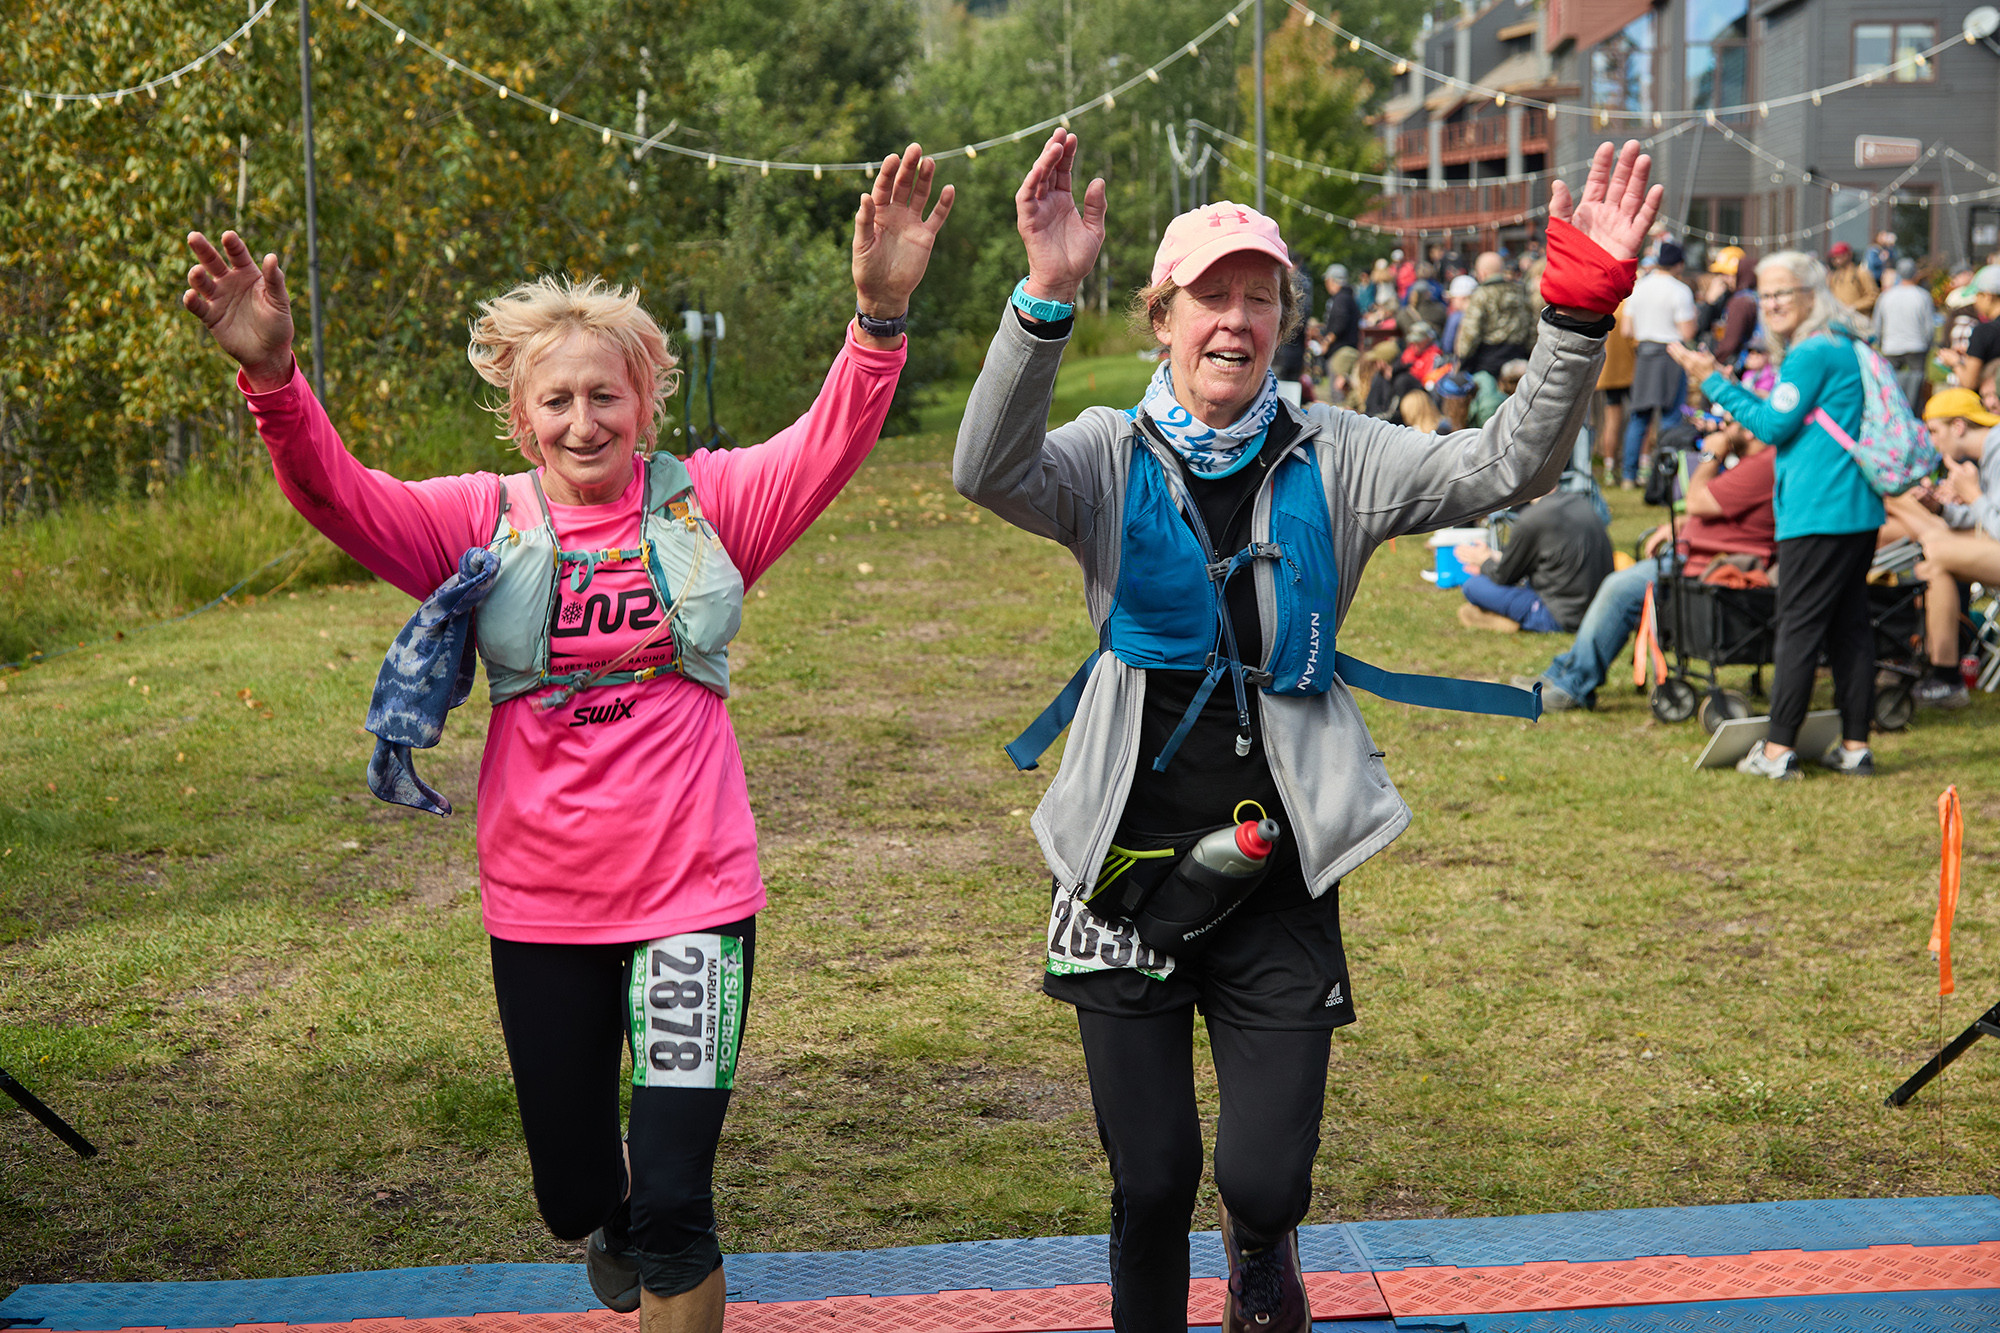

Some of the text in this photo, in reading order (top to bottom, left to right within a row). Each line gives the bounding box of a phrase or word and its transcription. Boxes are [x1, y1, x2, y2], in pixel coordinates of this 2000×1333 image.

[551, 664, 582, 672] OPPET
[628, 654, 665, 664] RACING
[1297, 612, 1320, 690] NATHAN
[634, 955, 646, 984] 26.2
[632, 985, 644, 1022] MILE
[649, 946, 705, 1071] 2878
[704, 957, 717, 1062] MARIAN MEYER
[1324, 995, 1344, 1008] adidas
[634, 1031, 646, 1069] 2025
